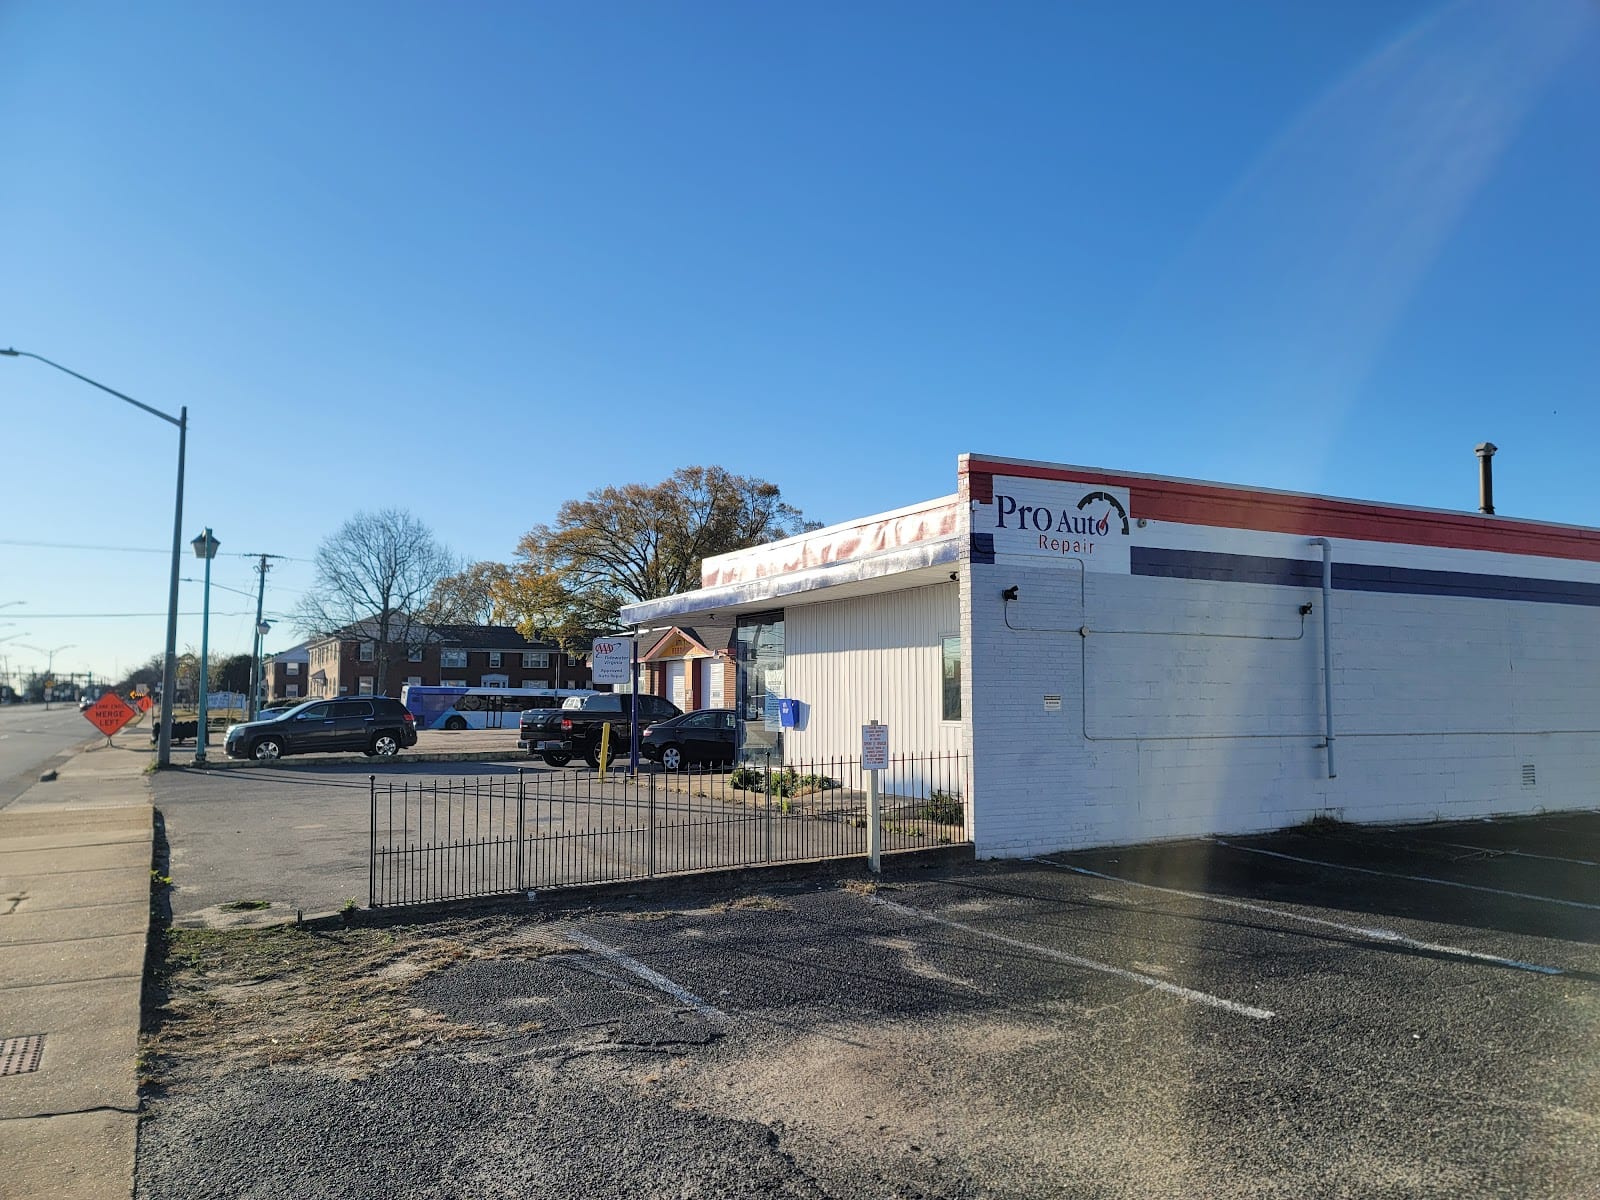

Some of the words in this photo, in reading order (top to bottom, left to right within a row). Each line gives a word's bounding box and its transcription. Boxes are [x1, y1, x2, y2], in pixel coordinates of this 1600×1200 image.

[995, 494, 1053, 532] Pro
[1055, 509, 1109, 537] Auto
[1039, 534, 1095, 555] Repair
